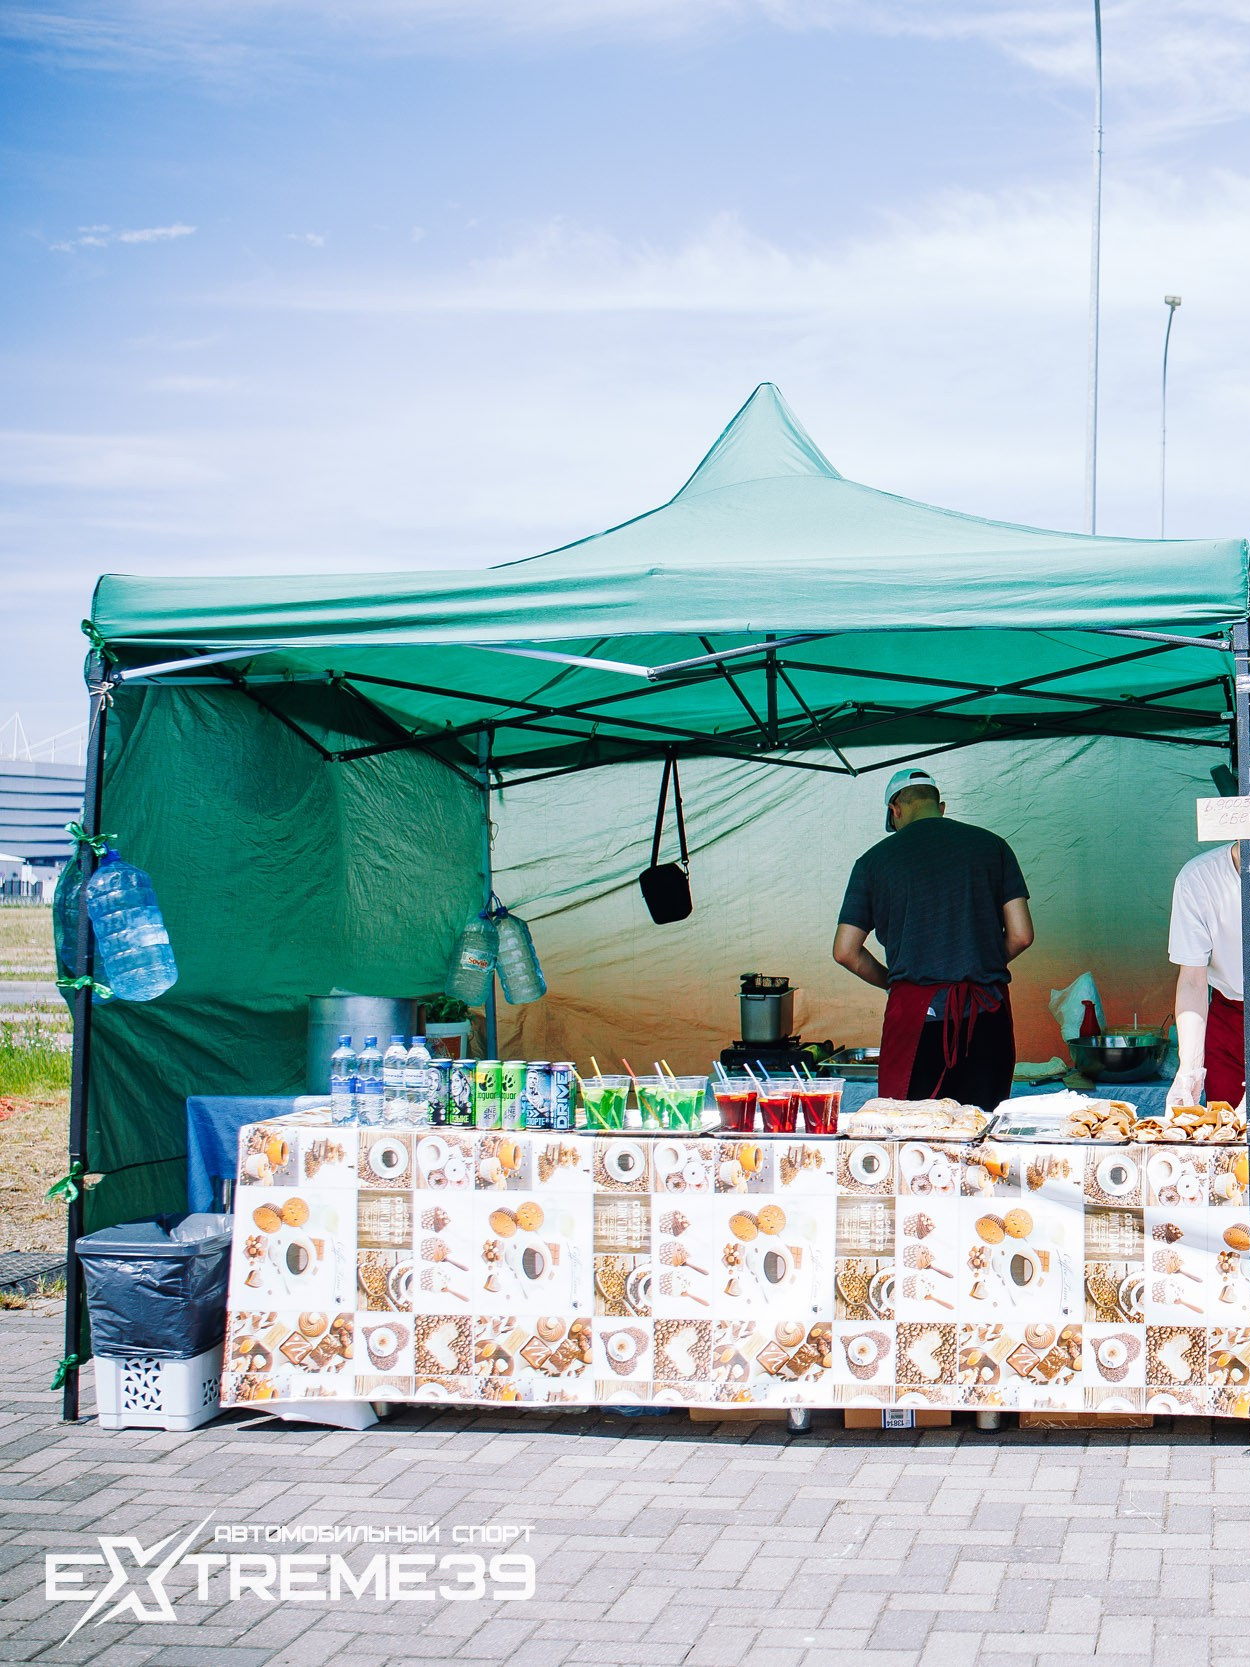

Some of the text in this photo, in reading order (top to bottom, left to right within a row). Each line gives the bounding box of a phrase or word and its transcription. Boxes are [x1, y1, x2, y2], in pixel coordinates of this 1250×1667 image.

[556, 1072, 569, 1129] DRIVE
[380, 1221, 390, 1241] DENY
[395, 1196, 403, 1244] COFFEE
[616, 1225, 627, 1245] DENY
[632, 1200, 640, 1248] COFFEE
[860, 1228, 870, 1249] DENY
[875, 1203, 884, 1251] COFFEE
[1124, 1213, 1132, 1255] COFFEE
[1109, 1233, 1119, 1253] DENY
